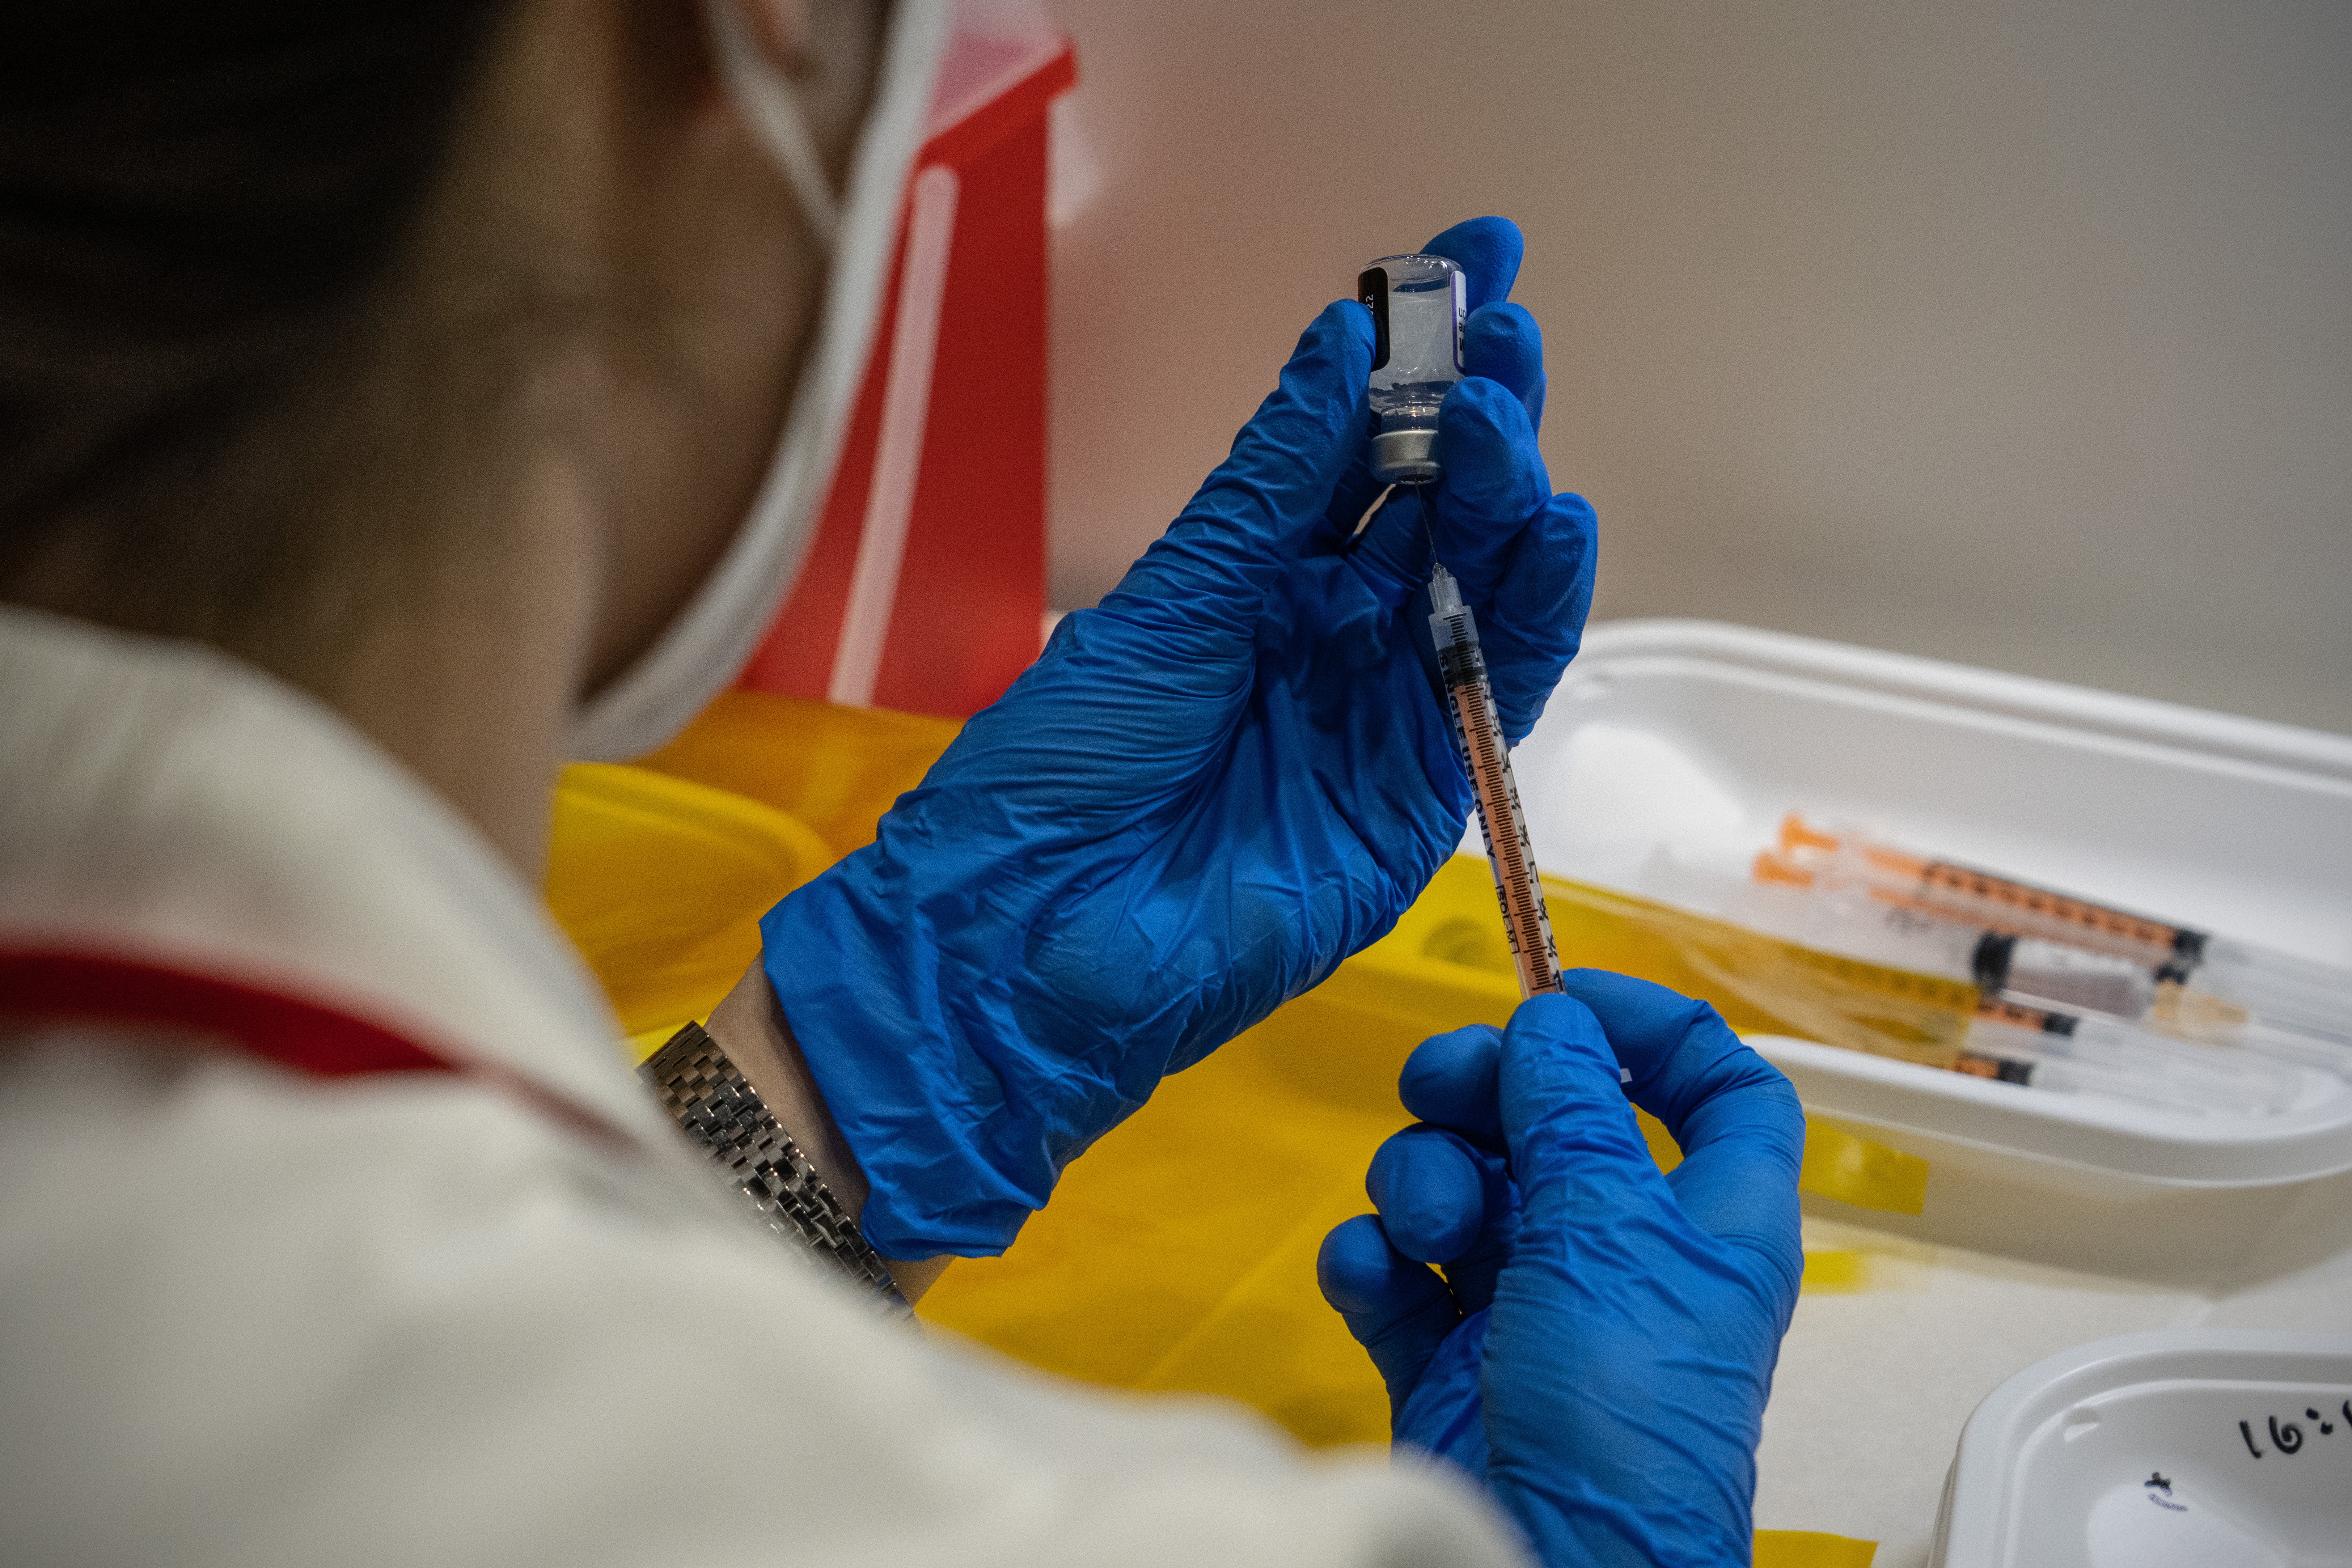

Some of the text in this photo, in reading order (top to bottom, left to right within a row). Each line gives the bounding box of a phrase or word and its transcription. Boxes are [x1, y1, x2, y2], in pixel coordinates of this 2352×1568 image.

[1439, 653, 1496, 858] SINGLE USE ONLY
